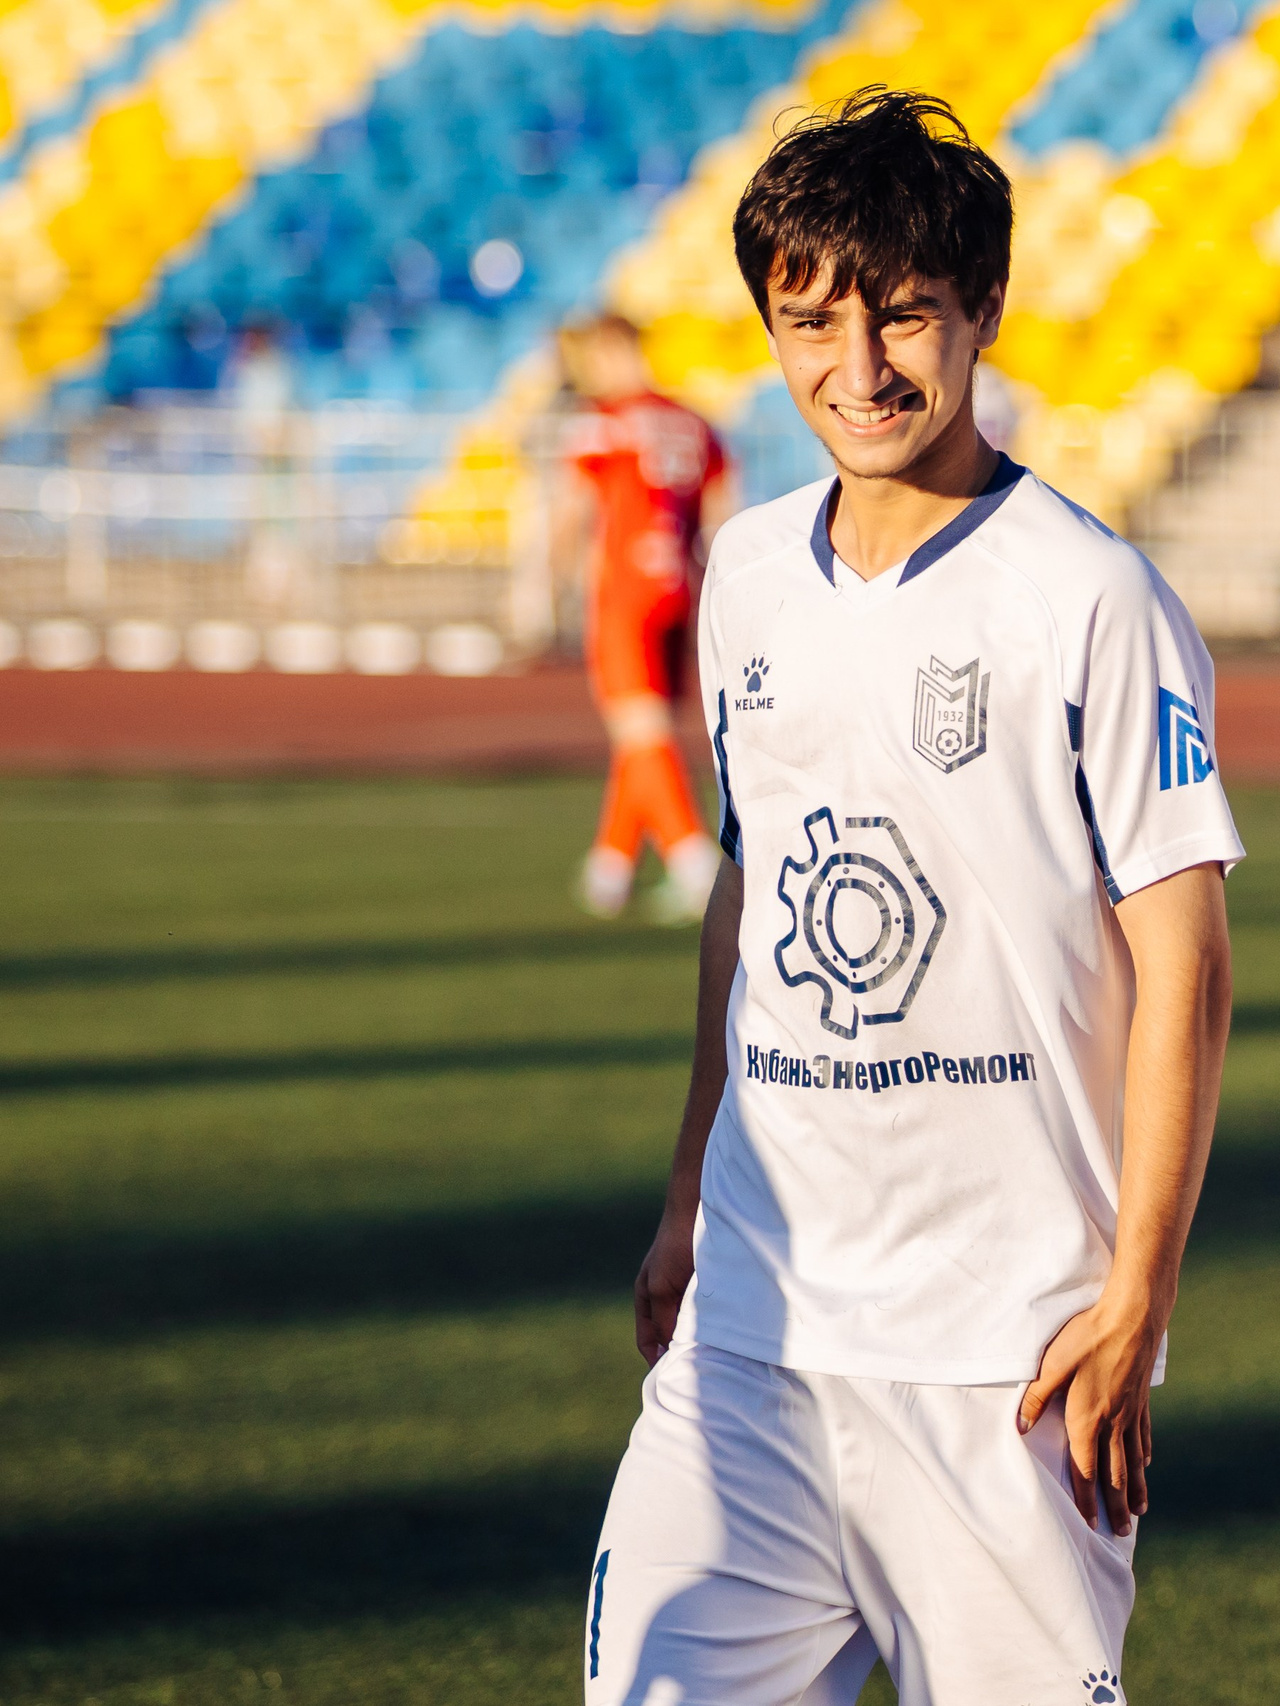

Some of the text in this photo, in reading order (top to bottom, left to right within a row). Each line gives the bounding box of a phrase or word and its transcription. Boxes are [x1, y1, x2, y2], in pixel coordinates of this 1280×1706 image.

[735, 697, 775, 711] KELME
[937, 710, 964, 722] 1932
[747, 1044, 1038, 1093] КубаньЭнергоРемонт
